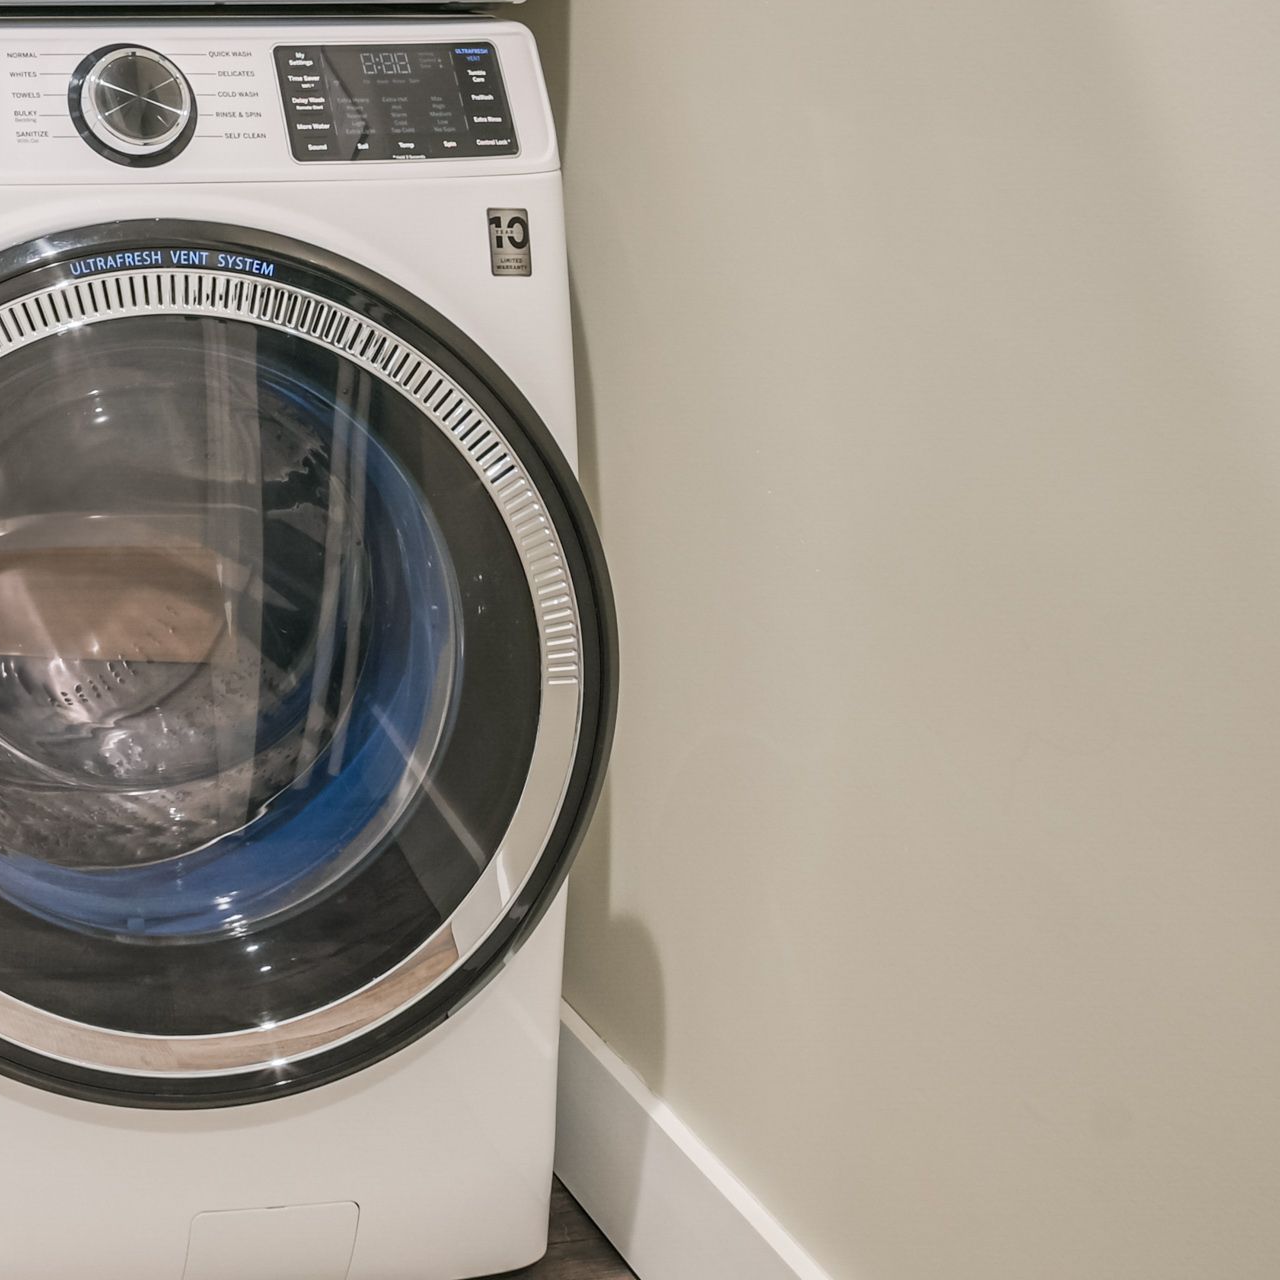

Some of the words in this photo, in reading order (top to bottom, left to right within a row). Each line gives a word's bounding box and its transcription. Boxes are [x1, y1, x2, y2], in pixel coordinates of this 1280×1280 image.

[208, 50, 231, 58] QUICK
[295, 51, 305, 59] My
[488, 215, 529, 250] 10
[69, 250, 162, 276] ULTRAFRESH
[170, 249, 209, 266] VENT
[217, 253, 275, 277] SYSTEM
